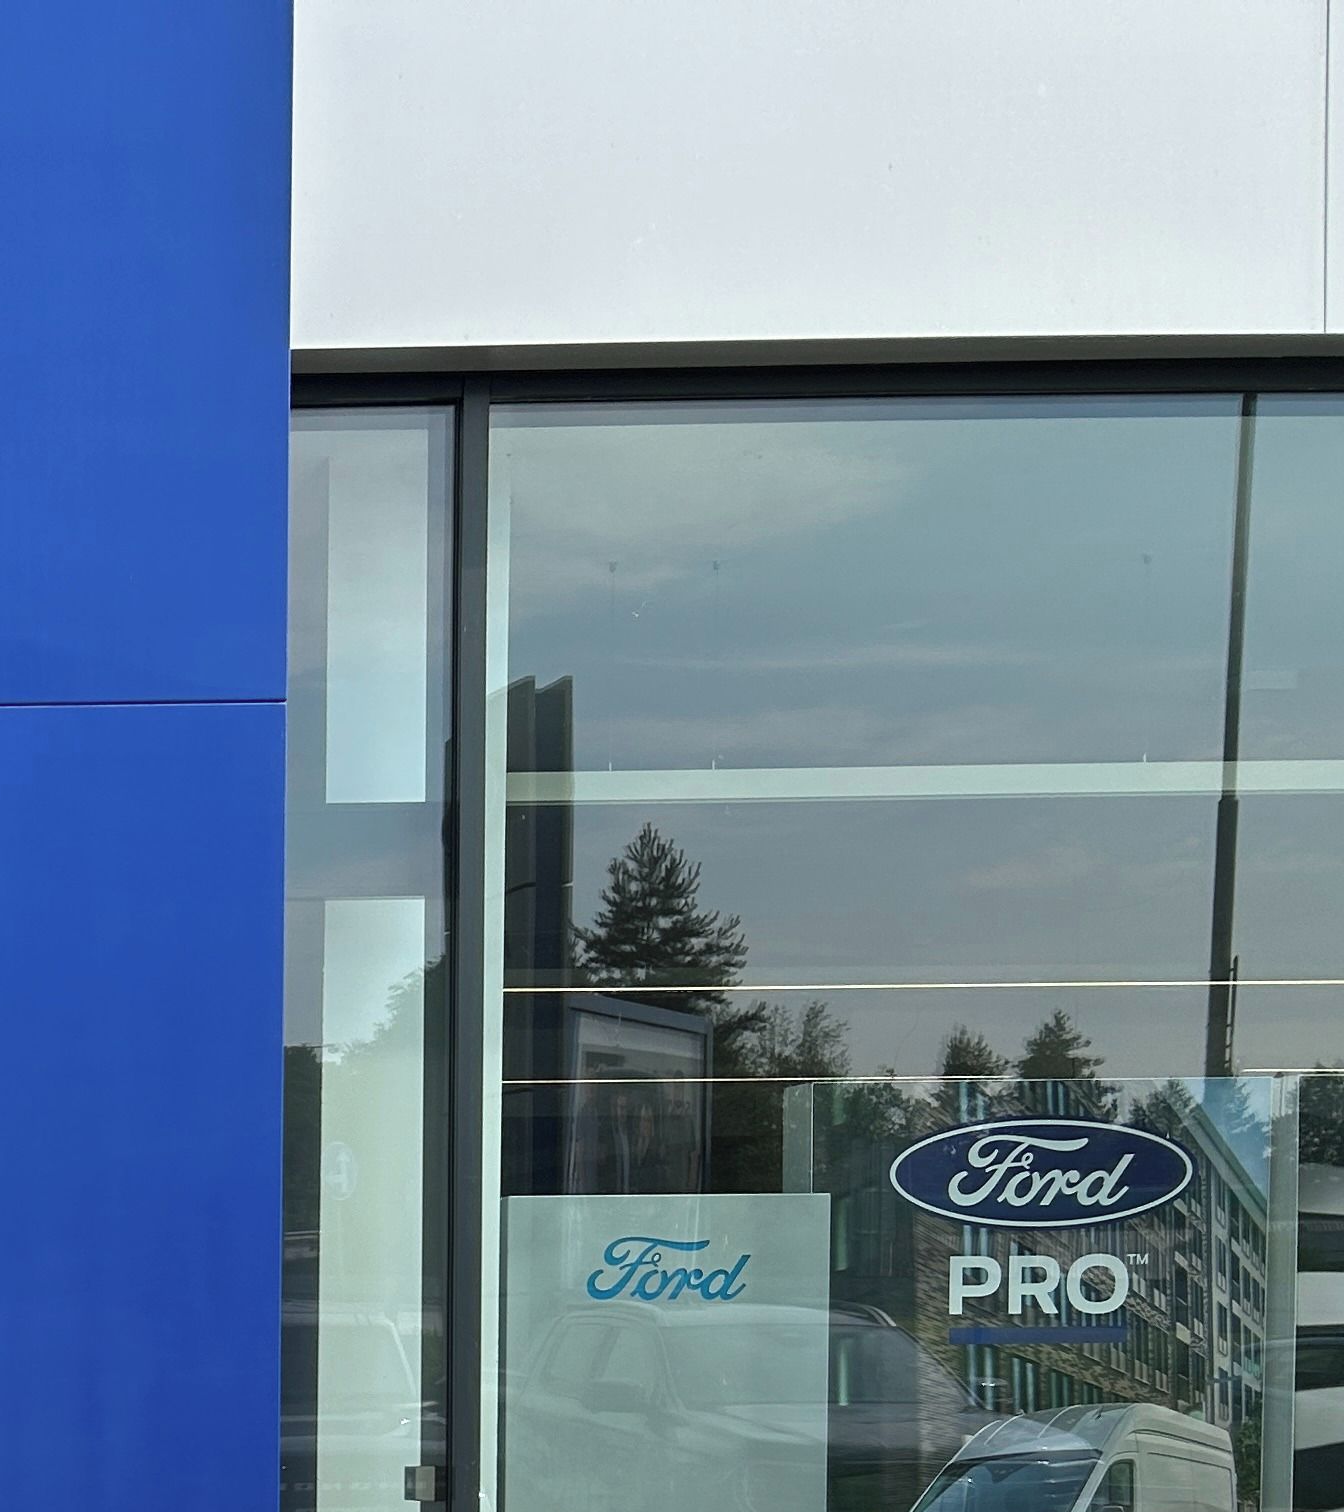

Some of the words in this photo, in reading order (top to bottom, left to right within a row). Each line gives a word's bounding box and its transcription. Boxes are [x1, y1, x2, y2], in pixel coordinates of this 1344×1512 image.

[947, 1134, 1135, 1207] Ford
[587, 1236, 752, 1301] Ford
[948, 1253, 1130, 1315] PRO
